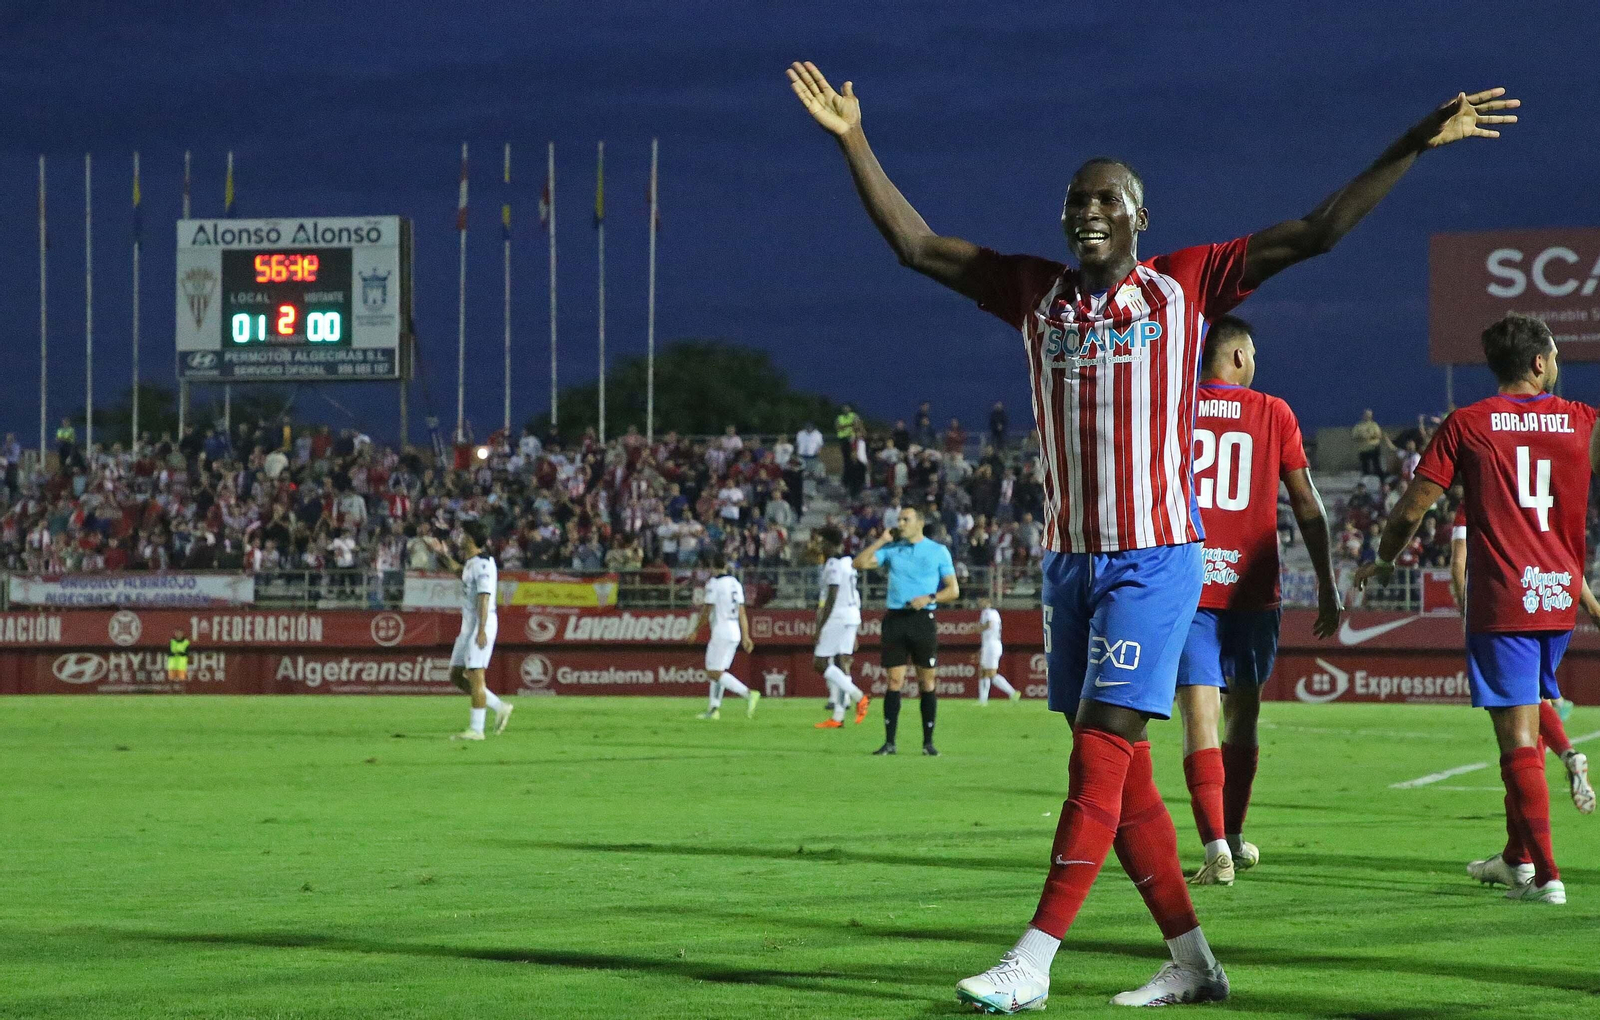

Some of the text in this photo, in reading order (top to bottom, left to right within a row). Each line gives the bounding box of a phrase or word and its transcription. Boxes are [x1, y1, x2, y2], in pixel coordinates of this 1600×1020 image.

[192, 221, 381, 246] Alonso Alonso
[230, 291, 270, 304] LOCAL
[278, 304, 296, 334] 2
[306, 311, 341, 342] 00
[1046, 321, 1163, 356] SCAMP
[294, 350, 364, 362] ALGECIRAS
[1107, 354, 1142, 364] Solutions
[1198, 400, 1241, 419] MARIO
[1491, 412, 1574, 433] BORJA FDEZ.
[1194, 429, 1253, 511] 20
[1516, 446, 1554, 532] 4
[1521, 566, 1572, 595] Algeciras
[1542, 588, 1573, 612] Gusta
[212, 613, 323, 642] FEDERACIÓN
[564, 612, 699, 640] Lavahostel
[773, 617, 816, 636] CLÍNI
[108, 652, 225, 670] HYUDAI
[276, 656, 432, 687] Algetransit
[108, 670, 225, 681] PERMTOR
[556, 665, 709, 684] Grazalema Moto
